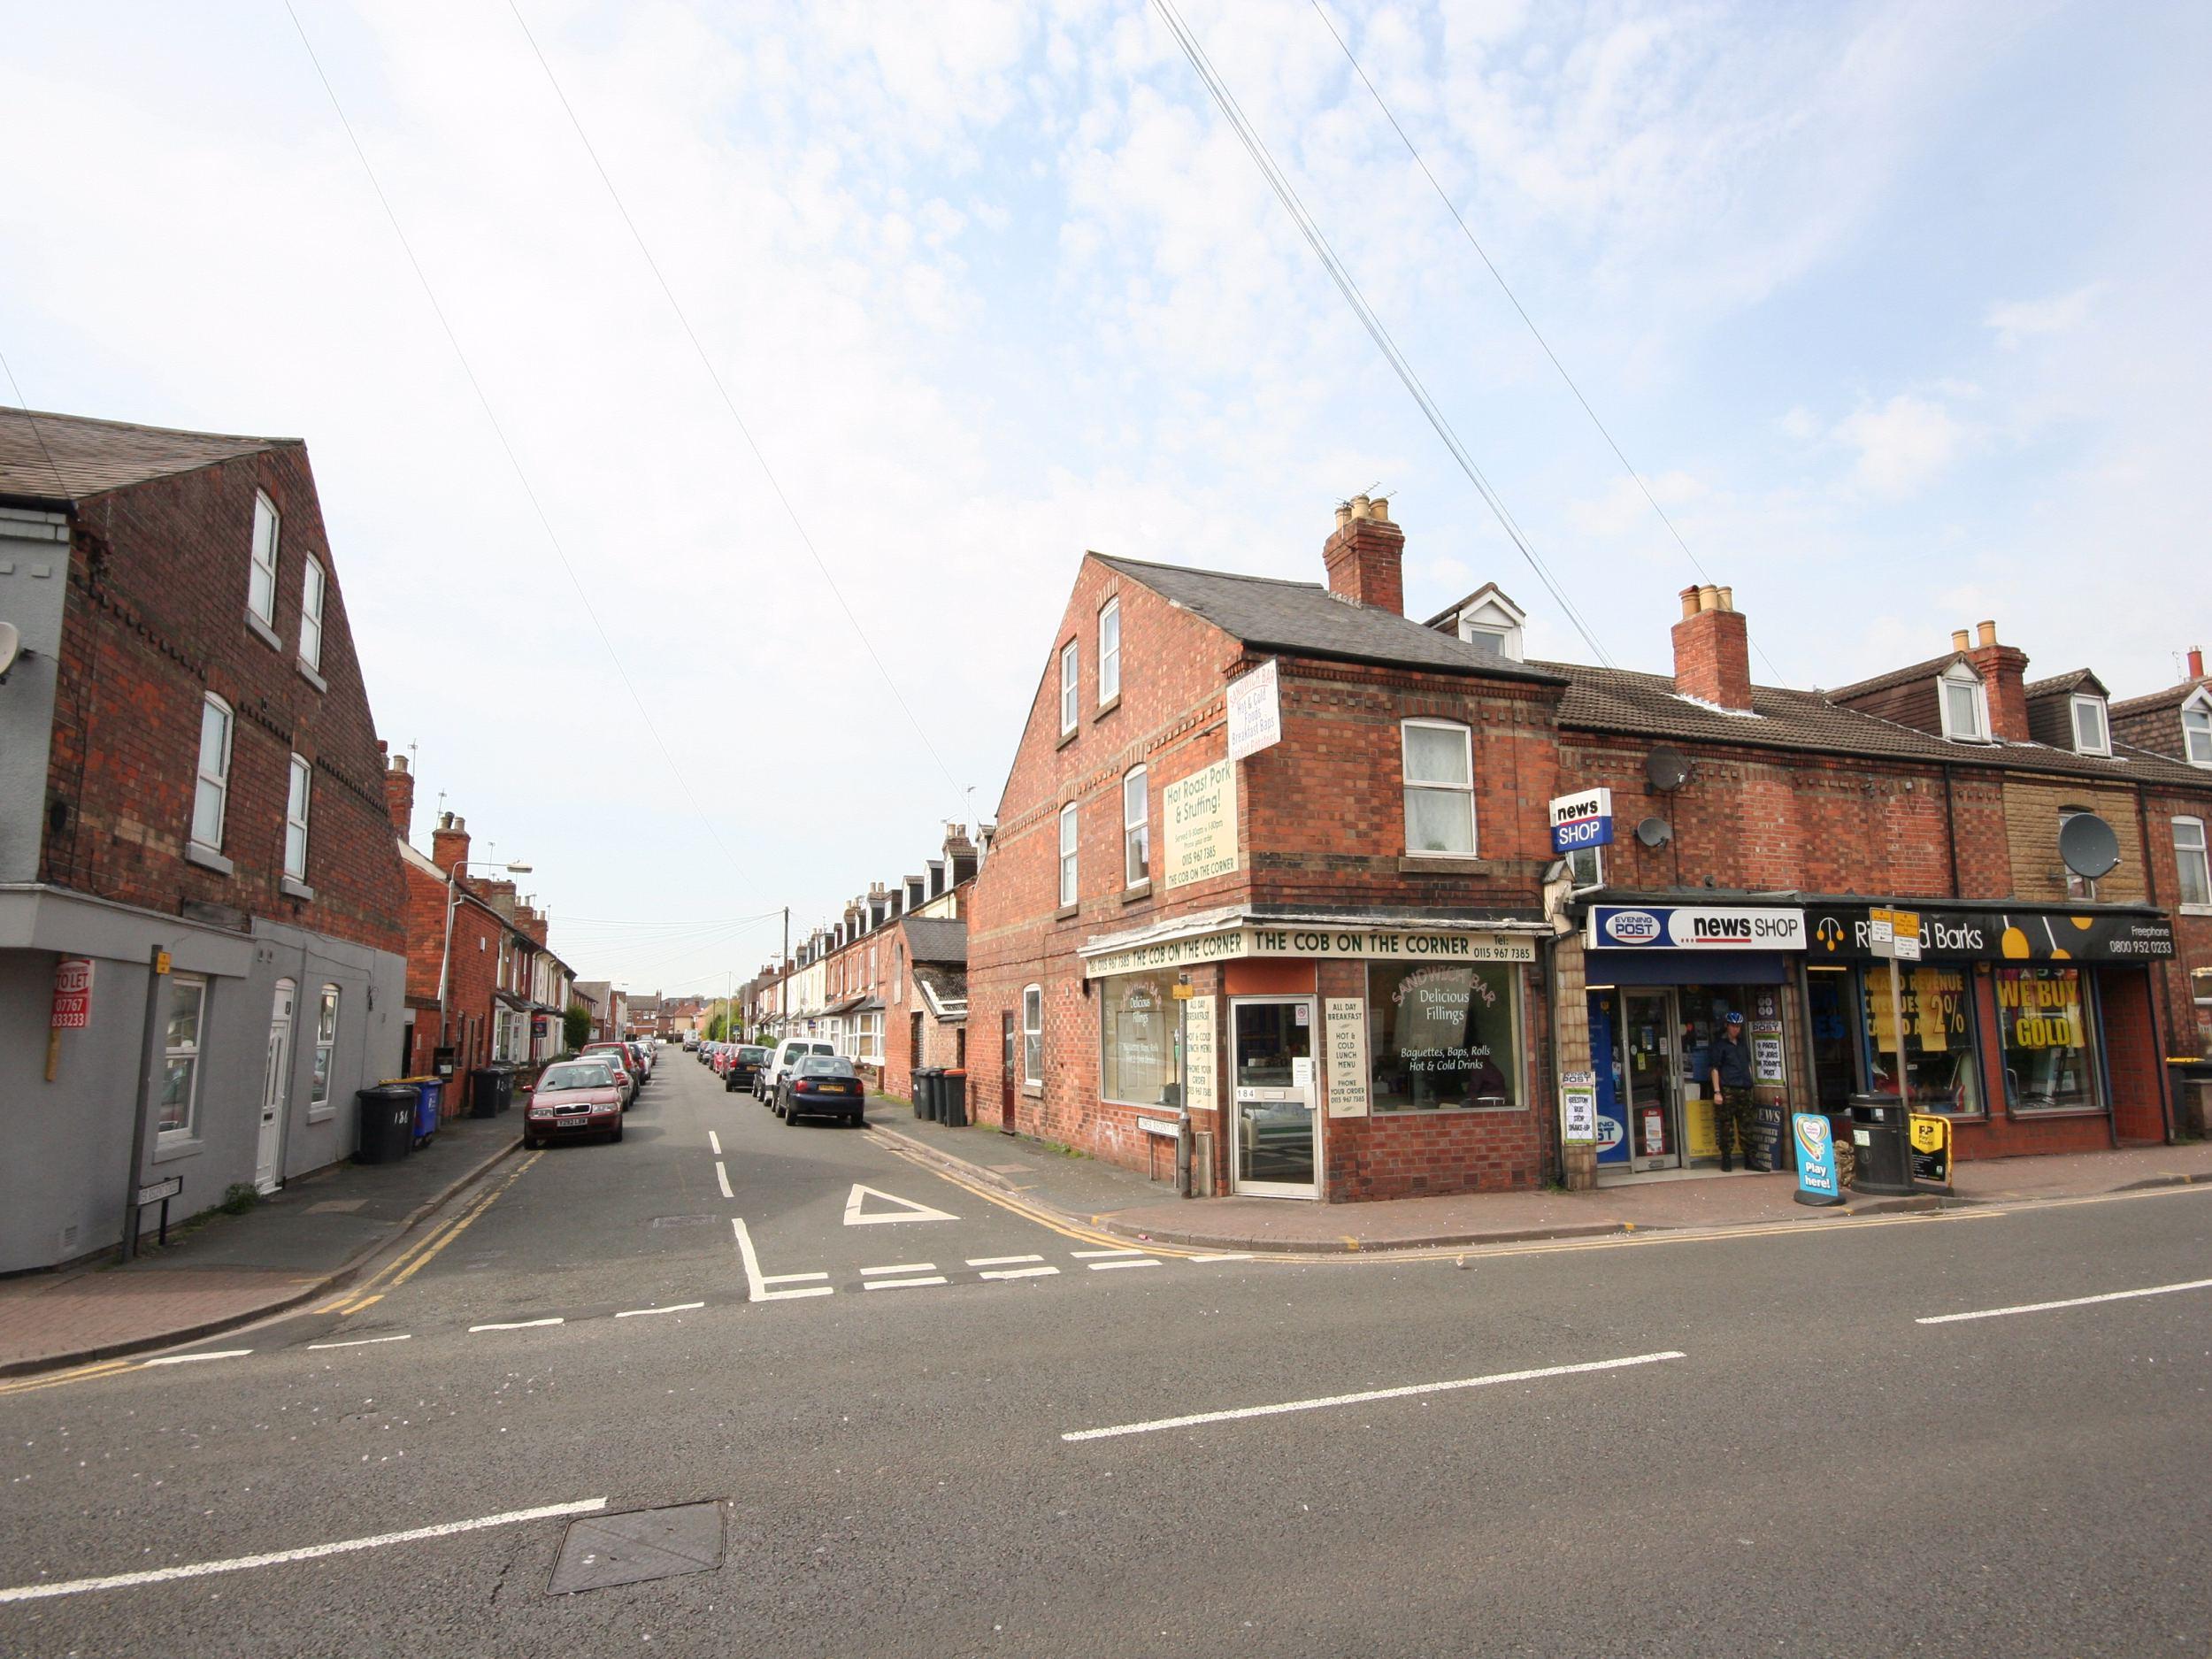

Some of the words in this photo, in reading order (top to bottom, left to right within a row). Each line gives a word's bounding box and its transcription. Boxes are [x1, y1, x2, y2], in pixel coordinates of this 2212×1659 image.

[1263, 668, 1275, 684] BAR
[1238, 699, 1247, 715] Hot
[1248, 695, 1252, 709] &
[1253, 687, 1266, 706] Cold
[1245, 708, 1261, 724] Foods
[1233, 724, 1258, 745] Breakfast
[1260, 717, 1274, 734] Baps
[1168, 786, 1180, 806] Hot
[1183, 773, 1207, 798] Roast
[1210, 762, 1231, 787] Pork
[1176, 805, 1181, 824] &
[1184, 788, 1220, 821] Stuffing!
[1557, 799, 1598, 820] news
[1559, 821, 1600, 844] SHOP
[1182, 854, 1192, 866] 0115
[1193, 849, 1202, 864] 967
[1204, 845, 1216, 860] 7385
[1168, 873, 1177, 886] THE
[1178, 871, 1188, 884] COB
[1189, 868, 1199, 880] ON
[1200, 864, 1210, 876] THE
[1210, 857, 1234, 873] CORNER
[1616, 924, 1653, 935] POST
[1694, 917, 1751, 936] news
[1755, 918, 1798, 937] SHOP
[2131, 926, 2170, 940] Freephone
[1255, 932, 1286, 950] THE
[1294, 933, 1330, 951] COB
[1337, 933, 1363, 952] ON
[1369, 934, 1399, 953] THE
[1405, 935, 1469, 955] CORNER
[1494, 934, 1509, 946] Tel:
[1936, 923, 1983, 949] Barks
[1133, 949, 1147, 967] THE
[1149, 945, 1165, 964] COB
[1168, 943, 1180, 962] ON
[1184, 939, 1200, 958] THE
[1202, 933, 1241, 956] CORNER
[1473, 947, 1491, 958] 0115
[1494, 947, 1509, 959] 967
[1511, 949, 1530, 959] 7385
[2110, 941, 2131, 953] 0800
[2133, 941, 2149, 953] 952
[2151, 941, 2171, 954] 0233
[1118, 955, 1130, 968] 7385
[57, 973, 68, 988] TO
[71, 973, 88, 987] LET
[1392, 964, 1466, 1008] SANDWICH
[1470, 973, 1496, 1008] BAR
[1420, 987, 1470, 1003] Delicious
[1997, 980, 2032, 1006] WE
[2037, 980, 2077, 1006] BUY
[56, 998, 83, 1011] 07767
[52, 1013, 84, 1026] 833233
[1426, 1006, 1464, 1025] Fillings
[1931, 994, 1964, 1033] 2%
[2016, 1018, 2071, 1046] GOLD
[1402, 1047, 1445, 1061] Baguettes,
[1448, 1047, 1469, 1058] Baps,
[1471, 1045, 1490, 1056] Rolls
[1409, 1062, 1424, 1071] Hot
[1426, 1061, 1434, 1071] &
[1437, 1060, 1455, 1070] Cold
[1457, 1059, 1483, 1070] Drinks
[1237, 1089, 1254, 1098] 184
[1805, 1161, 1827, 1177] Play
[1805, 1175, 1831, 1189] here!
